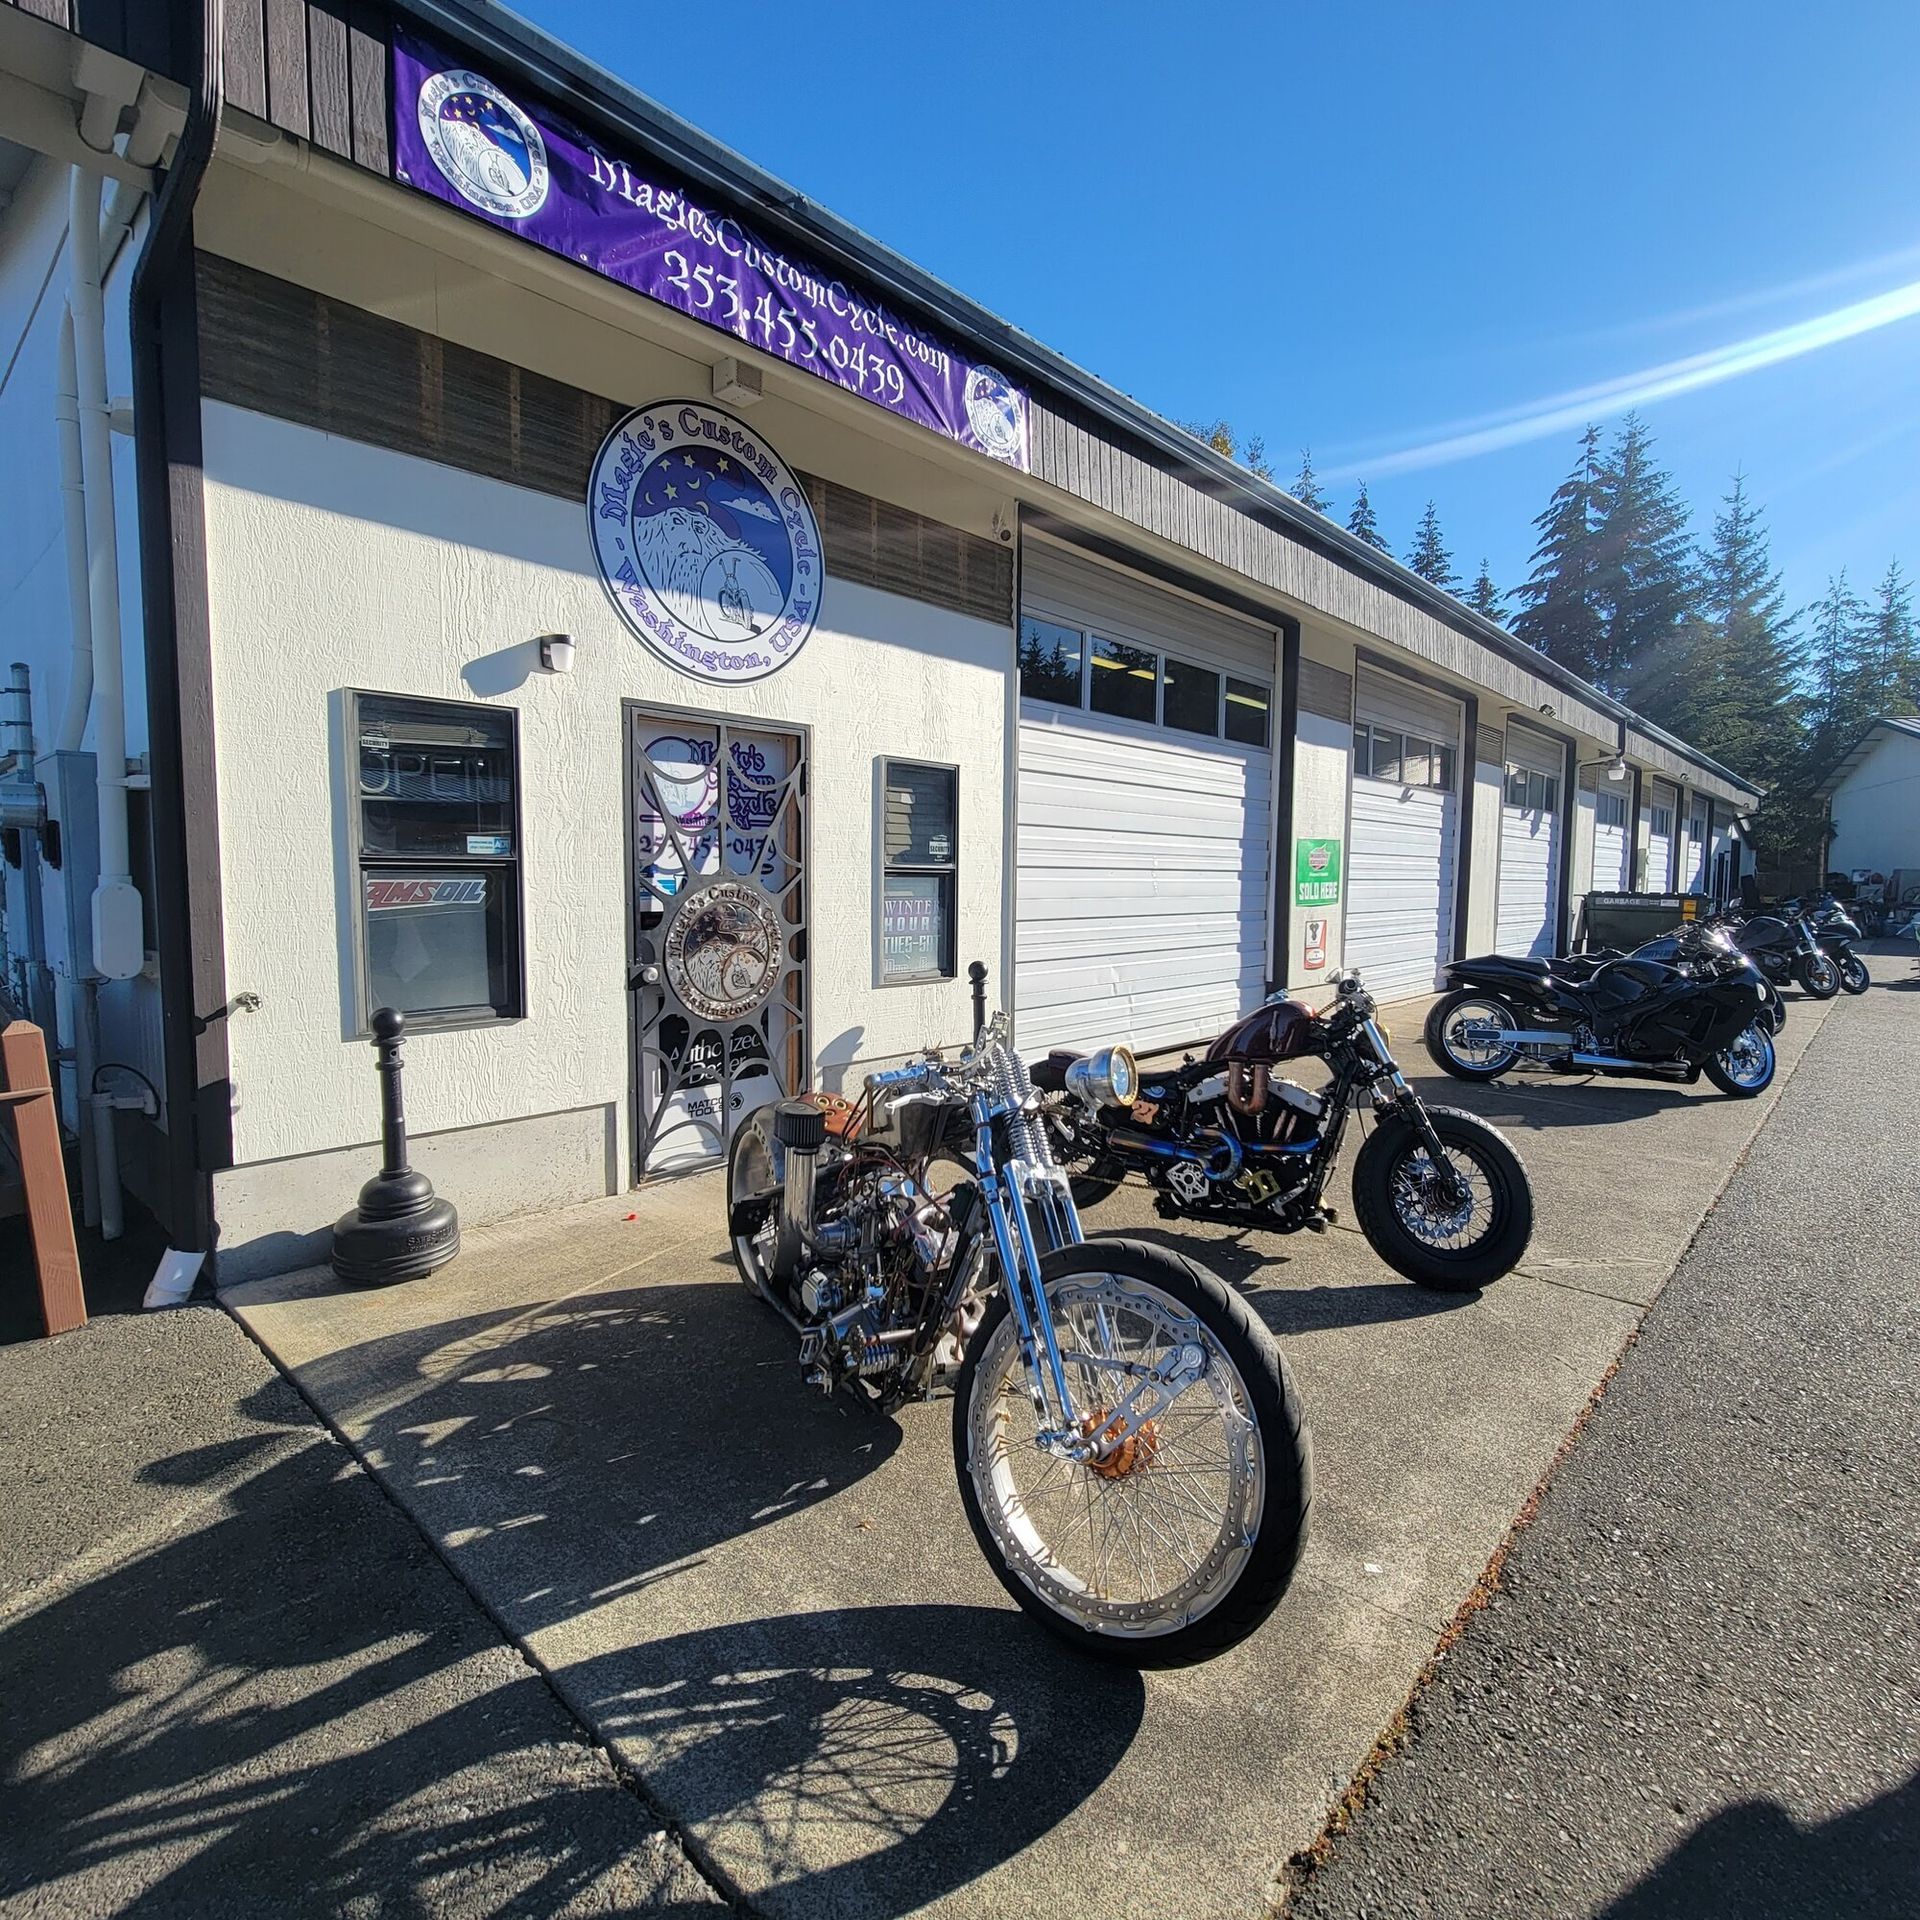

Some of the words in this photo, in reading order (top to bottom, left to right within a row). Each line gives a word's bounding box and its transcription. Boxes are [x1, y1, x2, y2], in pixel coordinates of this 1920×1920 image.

[462, 72, 522, 121] Custom
[525, 124, 543, 176] Cycle
[520, 186, 544, 211] USA
[586, 145, 950, 374] MagicsCustomCycle.com
[664, 250, 904, 403] 253.455.0439
[601, 416, 674, 527] Magic's
[678, 408, 779, 484] Custom
[780, 487, 817, 577] Cycle
[615, 557, 772, 672] Washington,
[769, 600, 812, 653] USA
[367, 880, 487, 911] AMSOIL
[708, 887, 760, 908] Custom
[885, 900, 939, 915] WINTER
[884, 916, 940, 932] HOURS
[670, 1034, 761, 1064] Authoize
